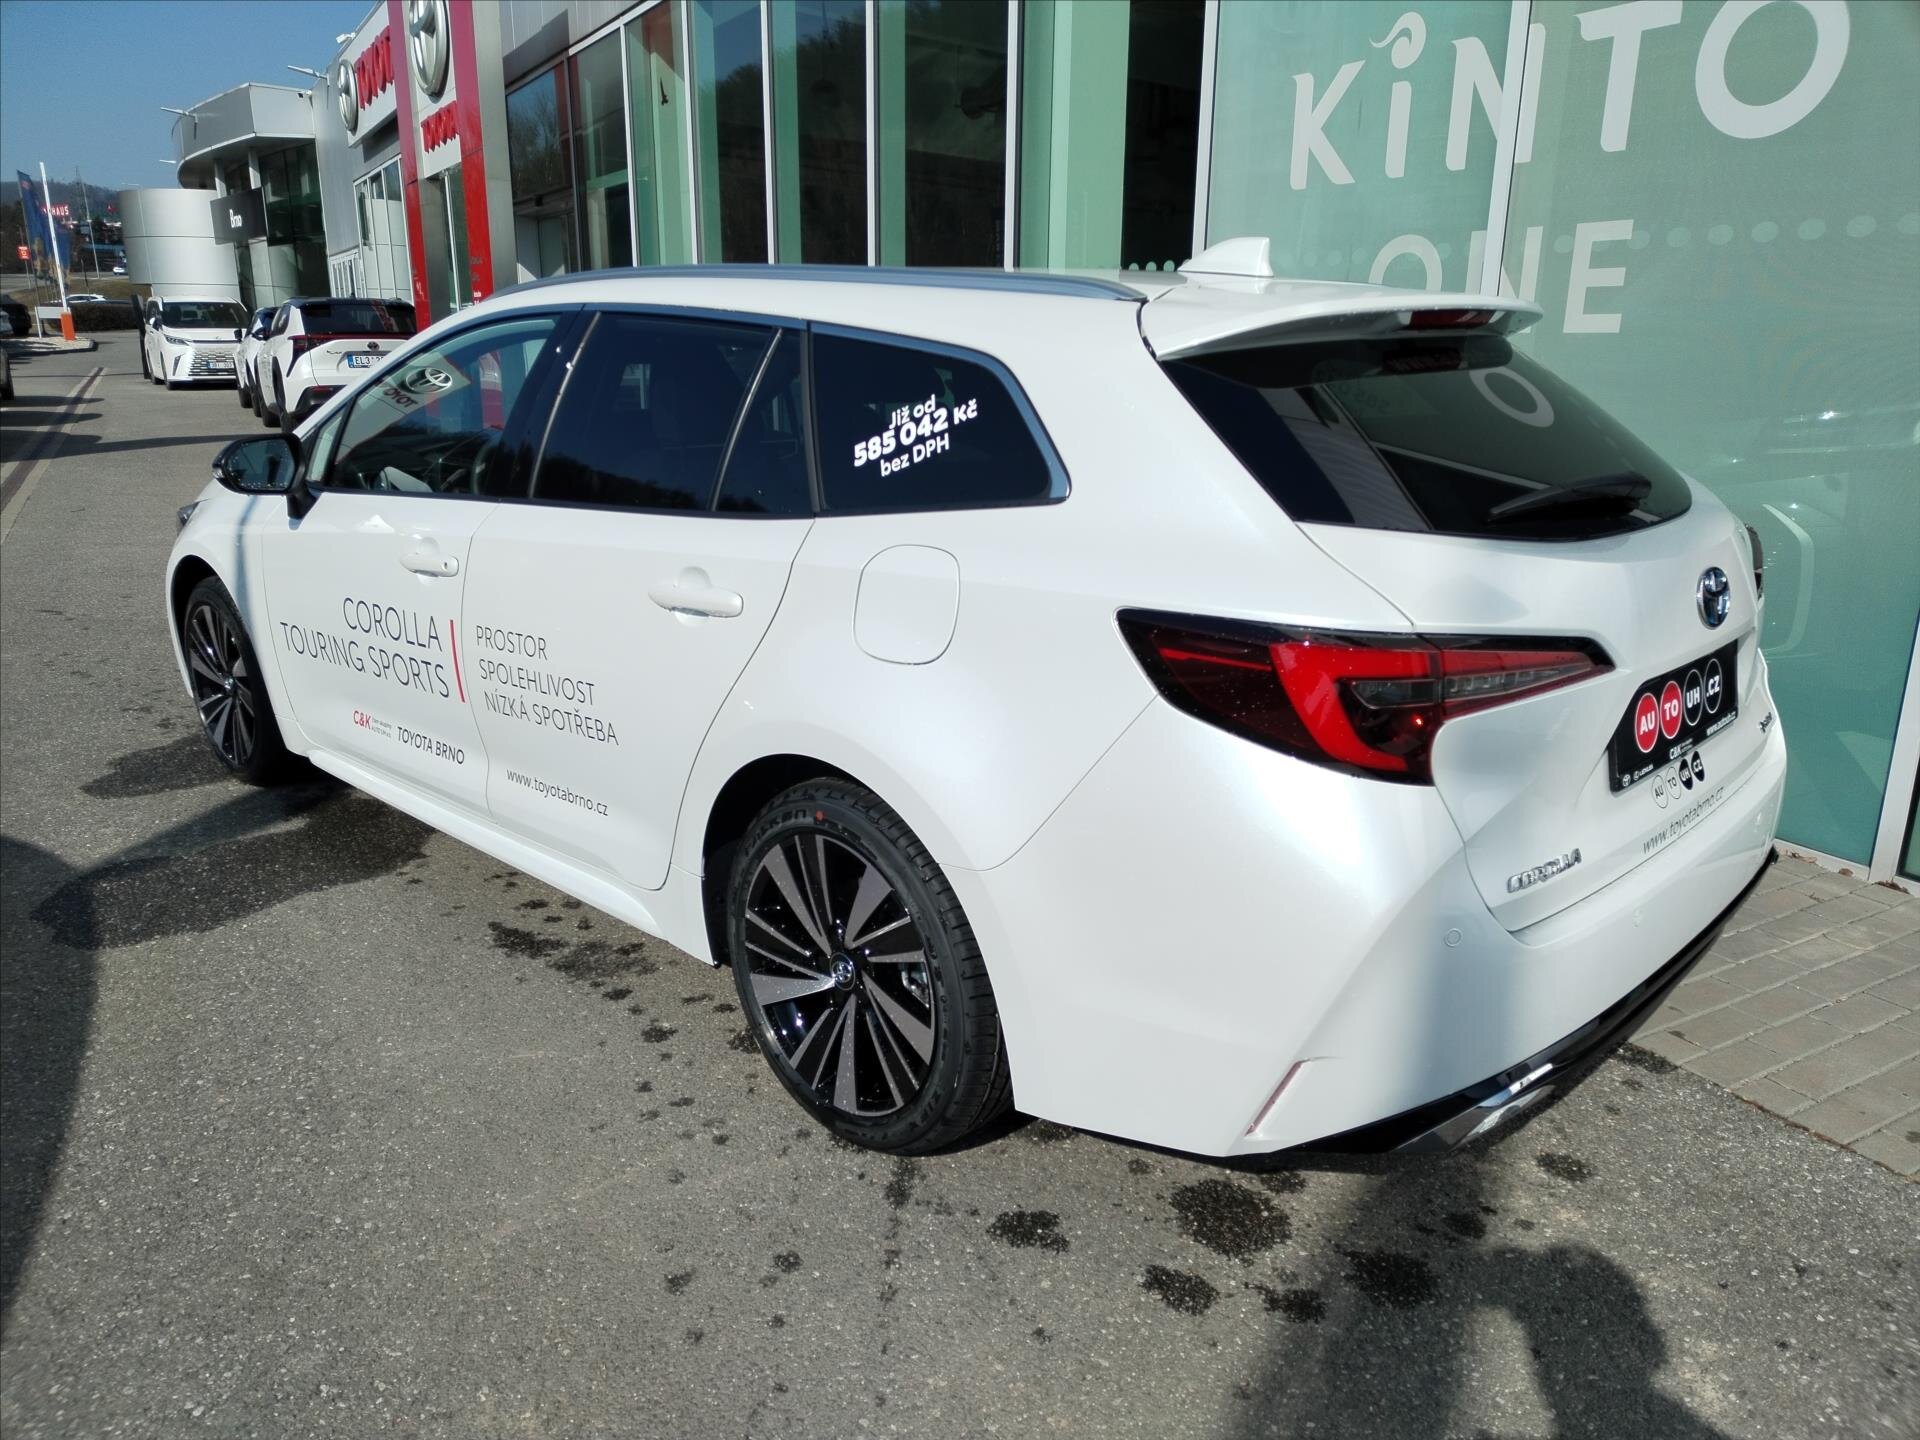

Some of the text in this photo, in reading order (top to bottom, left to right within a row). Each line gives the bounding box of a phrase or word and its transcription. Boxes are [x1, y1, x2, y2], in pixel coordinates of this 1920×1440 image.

[354, 25, 394, 111] TOYOT
[854, 398, 978, 467] 585 042 Kč
[889, 394, 936, 429] Již od
[880, 433, 949, 477] bez DPH
[343, 597, 442, 652] COROLLA
[476, 625, 547, 660] PROSTOR
[280, 622, 449, 698] TOURING SPORTS
[479, 659, 594, 705] SPOLEHLIVOST
[353, 710, 371, 730] C&K
[484, 689, 619, 746] NÍZKÁ SPOTŘEBA
[1640, 711, 1656, 735] AU
[1664, 699, 1679, 720] TO
[1686, 687, 1700, 708] UH
[397, 726, 433, 753] TOYOTA
[435, 741, 465, 764] BRNO
[506, 769, 609, 816] www.toyotabrno.cz
[1654, 785, 1664, 799] AU
[1668, 776, 1677, 789] TO
[1643, 785, 1724, 855] www.toyotabrno.cz
[1507, 848, 1582, 893] COROLLA
